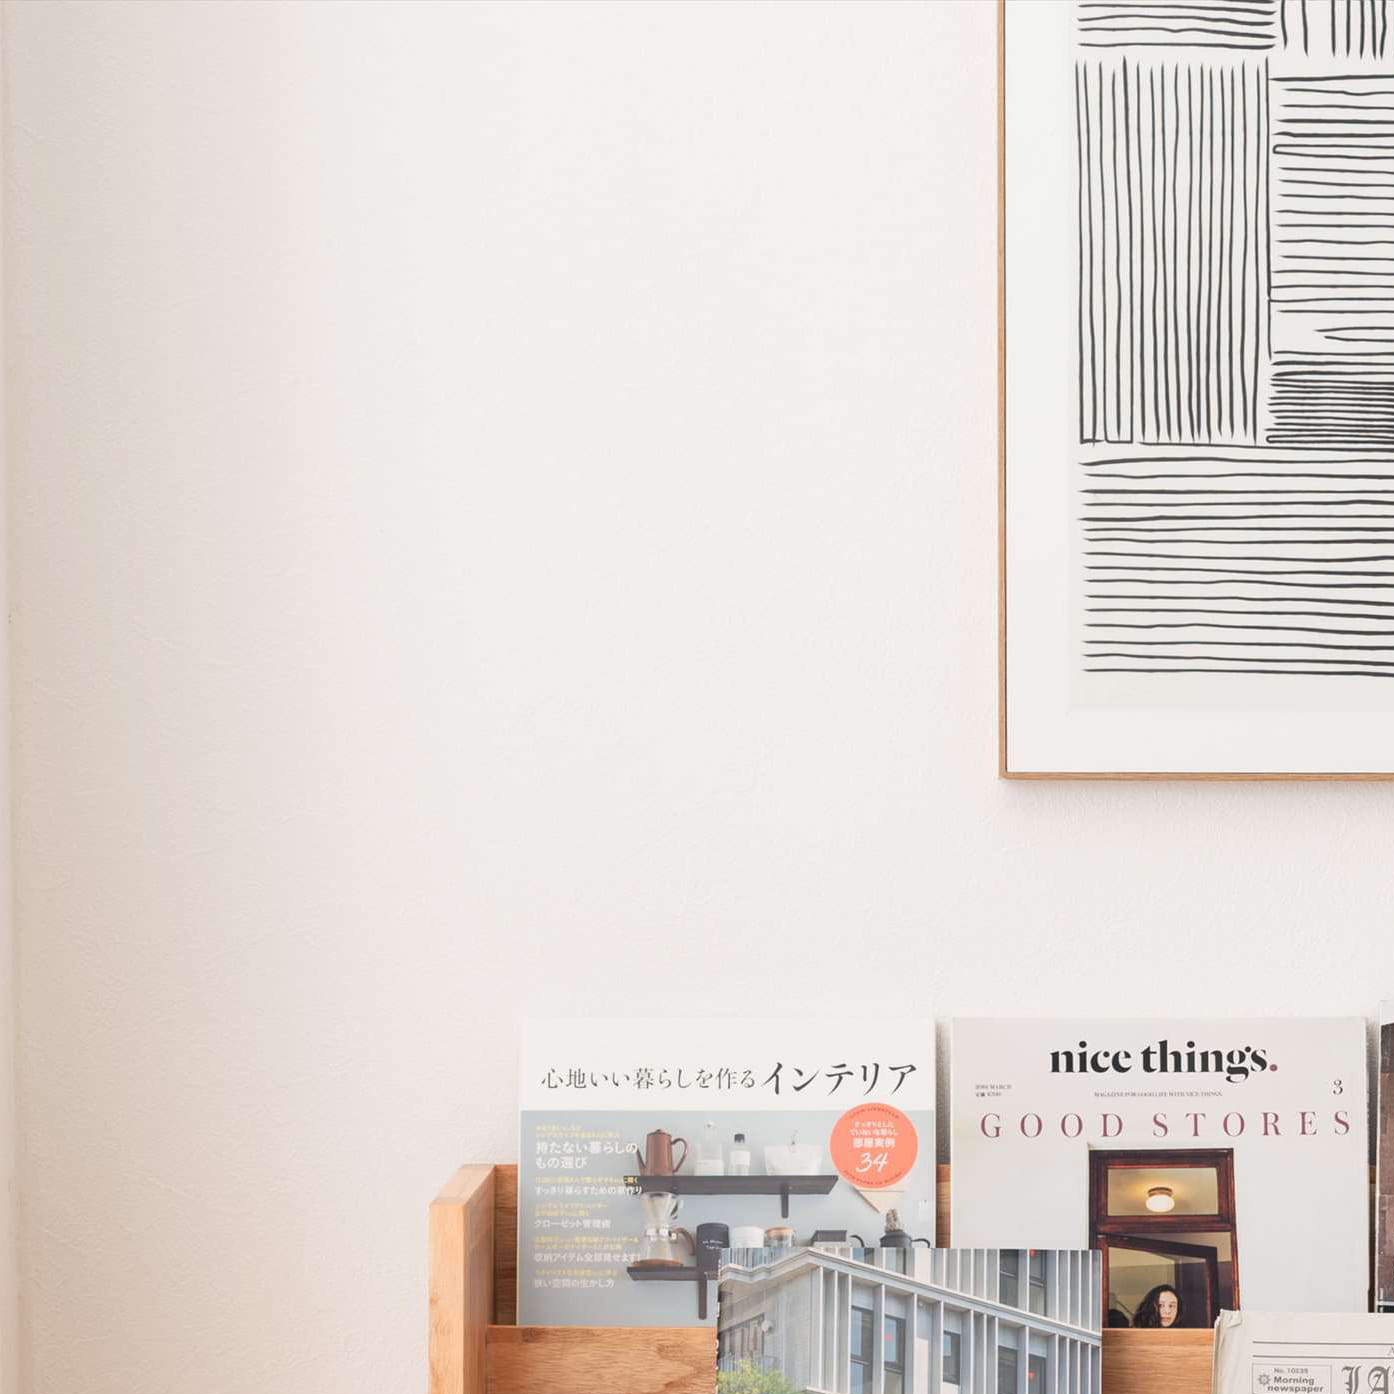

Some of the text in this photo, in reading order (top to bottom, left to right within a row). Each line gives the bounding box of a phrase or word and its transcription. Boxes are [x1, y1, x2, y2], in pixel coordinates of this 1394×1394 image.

[1050, 1039, 1278, 1083] nice things.
[1333, 1080, 1344, 1095] 3
[980, 1111, 1351, 1138] GOOD STORES
[856, 1152, 888, 1173] 34
[1273, 1376, 1315, 1385] Morning
